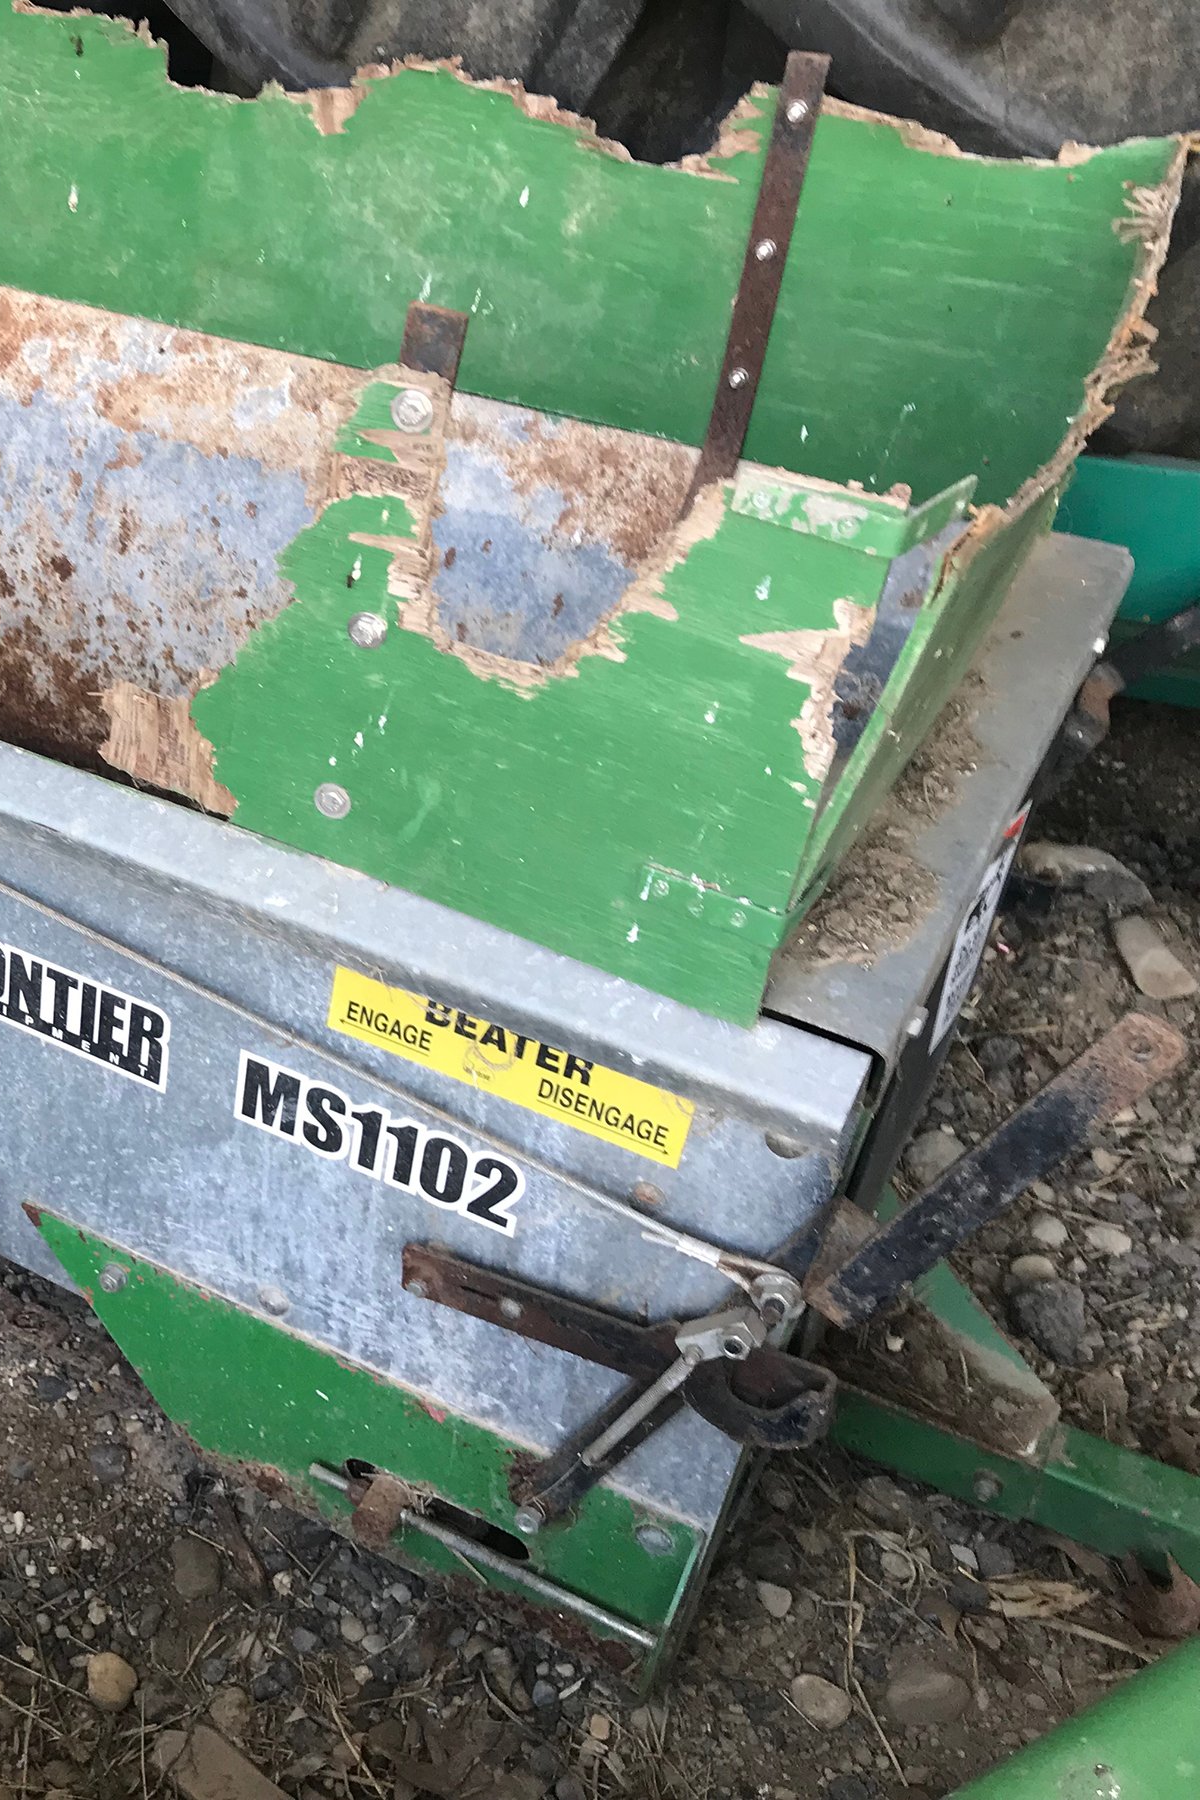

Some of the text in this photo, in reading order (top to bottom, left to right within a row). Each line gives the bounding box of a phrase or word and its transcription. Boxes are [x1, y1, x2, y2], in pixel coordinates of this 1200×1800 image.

[347, 1001, 433, 1051] ENGAGE
[425, 1000, 593, 1086] BEATER
[241, 1058, 518, 1228] MS1102
[538, 1079, 668, 1148] DISENGAGE
